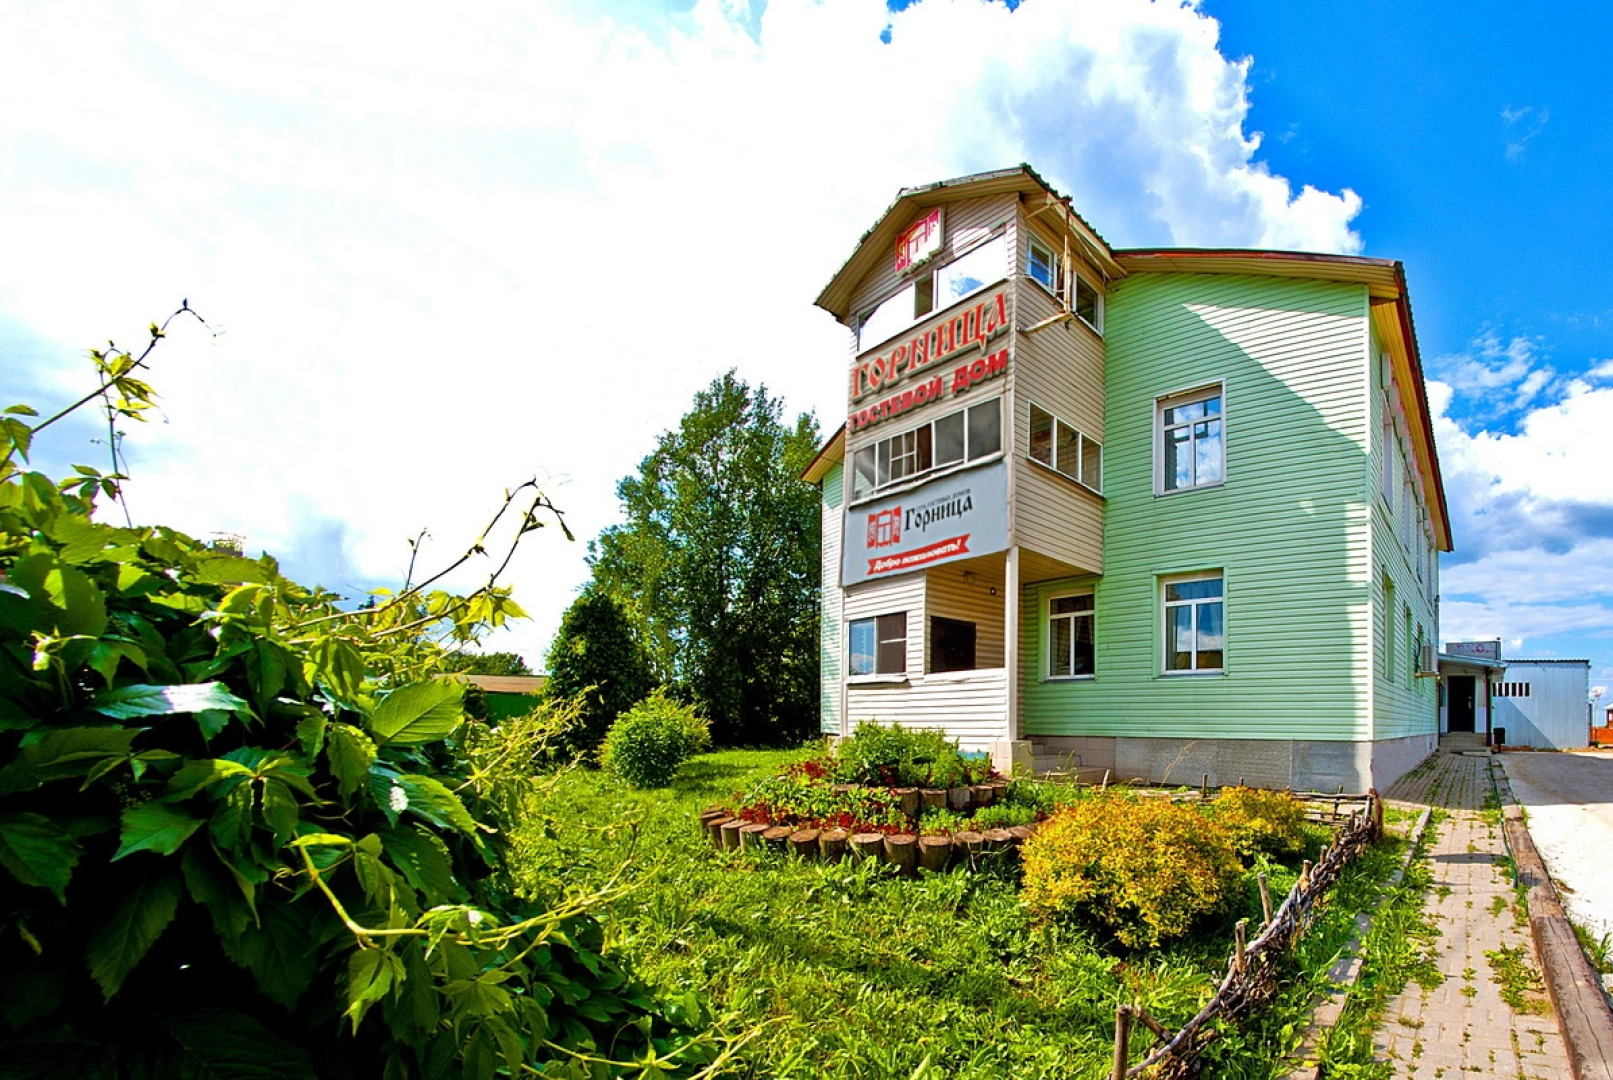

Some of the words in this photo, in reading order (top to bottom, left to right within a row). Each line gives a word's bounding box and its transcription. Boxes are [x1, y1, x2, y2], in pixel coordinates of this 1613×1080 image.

[852, 292, 1009, 398] ГОРНИЦА
[849, 374, 943, 432] ГОСТЕВОЙ
[952, 348, 1009, 394] ДОМ
[904, 495, 973, 532] Горница
[873, 558, 901, 572] Добро
